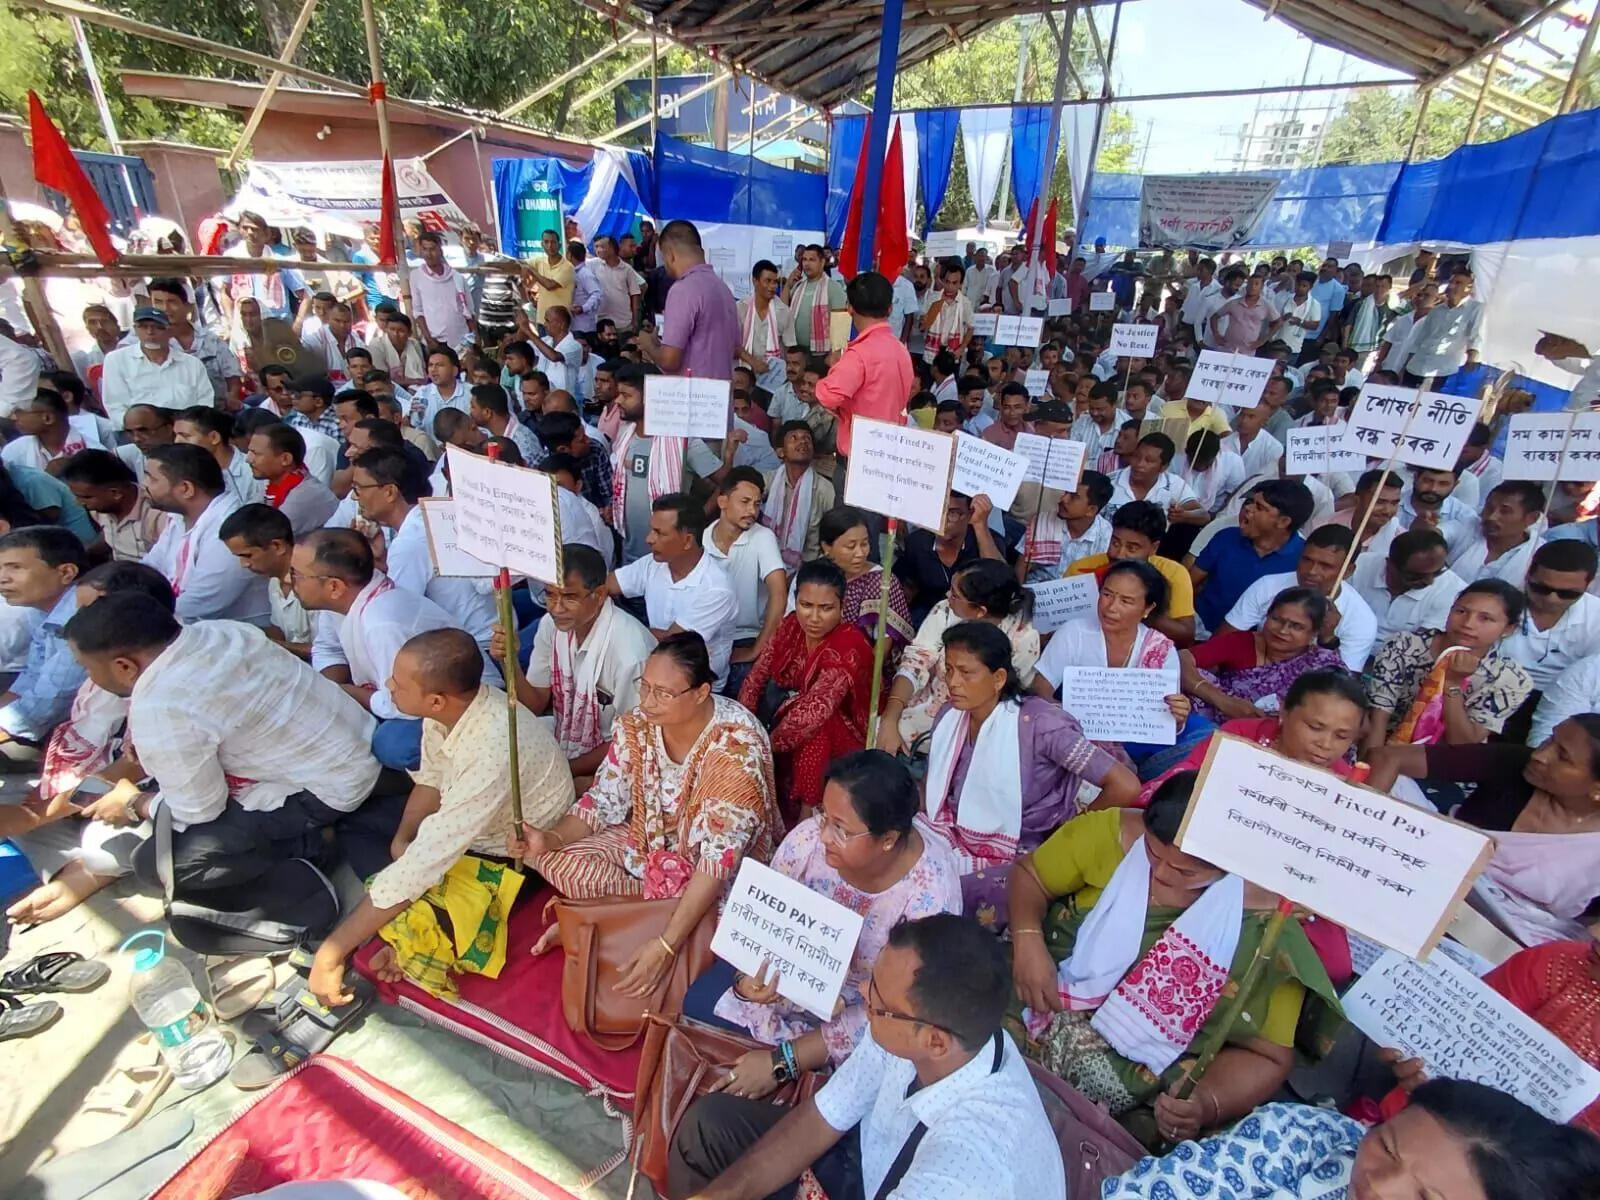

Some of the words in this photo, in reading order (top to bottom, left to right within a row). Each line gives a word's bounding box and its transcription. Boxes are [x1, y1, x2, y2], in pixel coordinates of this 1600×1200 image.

[1126, 327, 1156, 337] Justice
[1427, 399, 1472, 425] নীতি
[1356, 425, 1385, 446] বন্ধ
[1512, 429, 1532, 440] সম
[1537, 429, 1565, 441] কাম
[1570, 429, 1593, 441] সম
[634, 457, 645, 473] B
[958, 451, 983, 466] Equal
[984, 463, 1004, 476] work
[961, 440, 987, 456] Equal
[987, 452, 1003, 462] pay
[1004, 457, 1017, 467] for
[1036, 588, 1050, 596] ual
[1052, 585, 1067, 595] pay
[1072, 582, 1085, 590] for
[1037, 598, 1054, 608] qual
[1056, 593, 1079, 604] work
[1084, 727, 1111, 735] acility
[1333, 793, 1386, 821] Fixed
[1392, 815, 1431, 839] Pay
[747, 885, 787, 914] FIXED
[789, 908, 817, 929] PAY
[820, 922, 844, 943] কৰ্ম
[761, 917, 795, 946] চাকৰি
[797, 968, 829, 993] কৰক
[1382, 968, 1452, 1024] Experience
[1402, 969, 1467, 1022] Education
[1440, 968, 1478, 1000] Fixed
[1476, 1000, 1504, 1021] pay
[1507, 1022, 1573, 1077] employee
